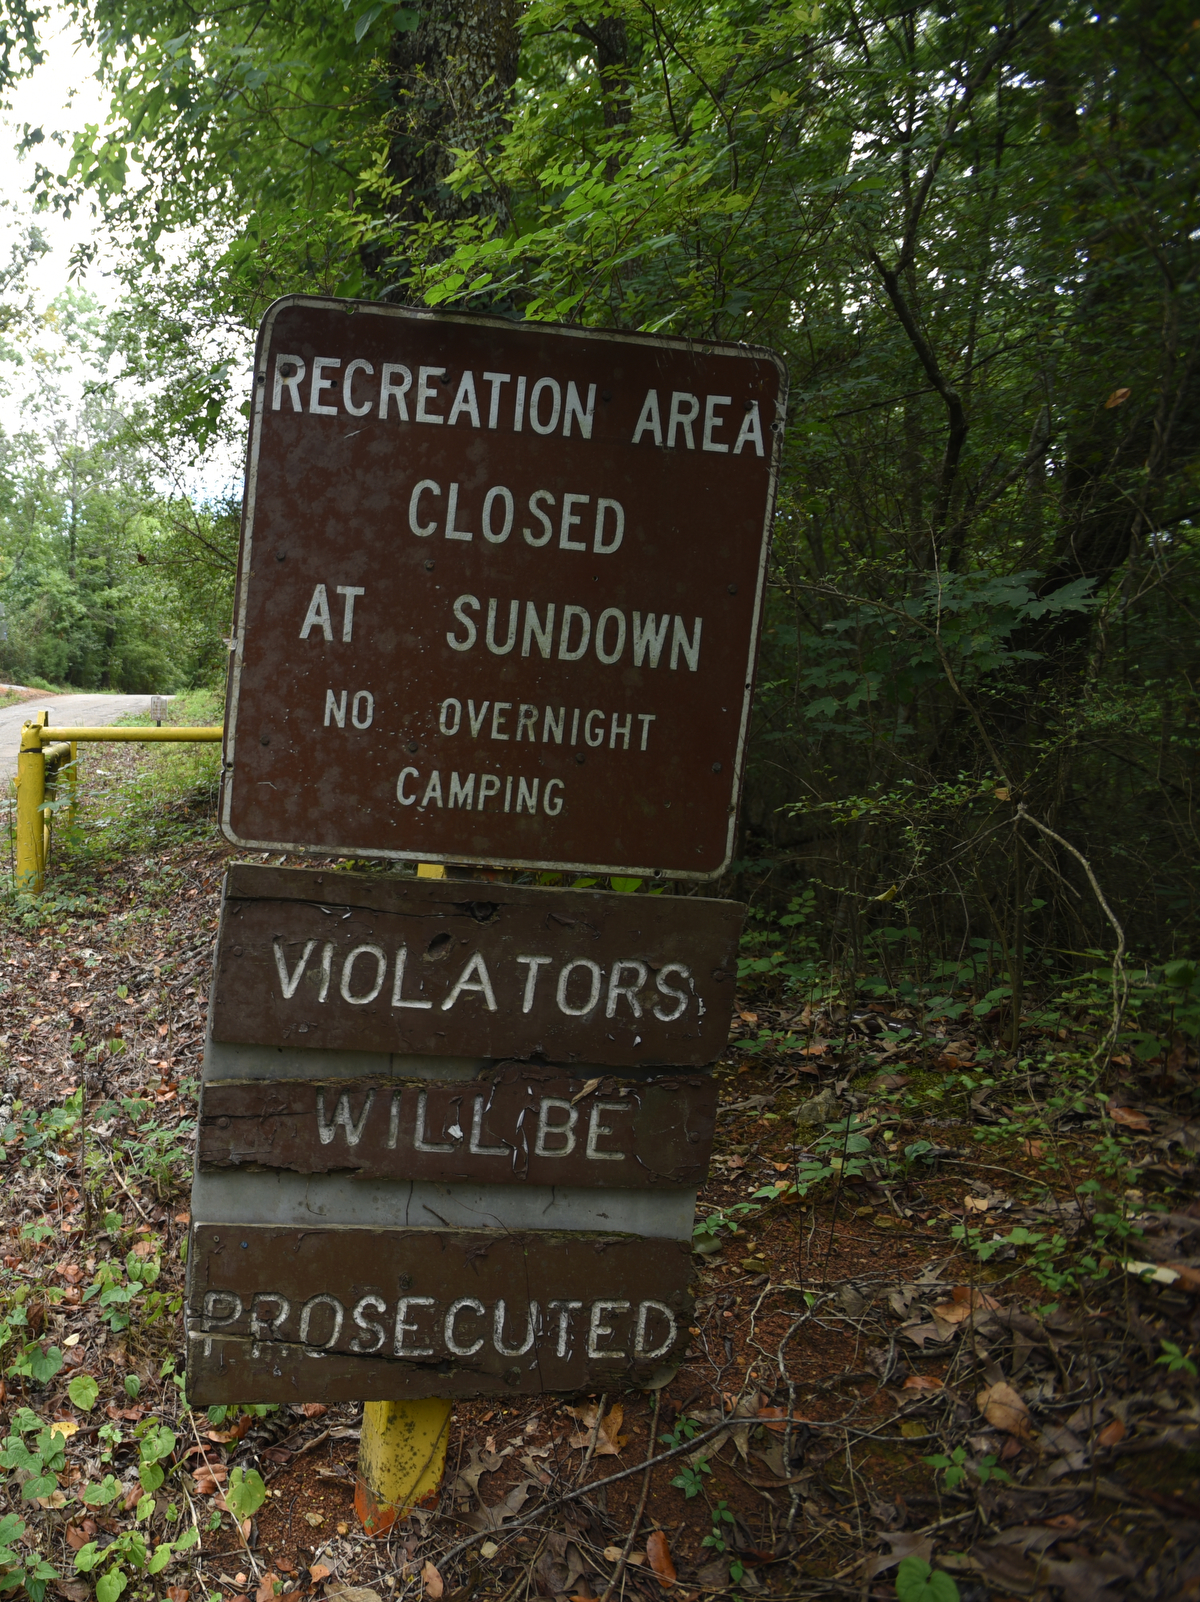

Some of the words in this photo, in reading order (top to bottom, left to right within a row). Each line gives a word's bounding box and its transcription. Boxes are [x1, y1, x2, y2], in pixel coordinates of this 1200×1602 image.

[271, 353, 597, 440] RECREATION
[631, 388, 765, 457] AREA
[407, 478, 626, 555] CLOSED
[299, 583, 366, 643] AT
[446, 594, 702, 672] SUNDOWN
[323, 688, 375, 730] NO
[439, 697, 656, 752] OVERNIGHT
[396, 766, 566, 817] CAMPING
[272, 936, 692, 1022] VIOLATORS
[315, 1086, 511, 1156] WILL
[534, 1096, 633, 1160] BE
[200, 1289, 680, 1360] PROSECUTED
